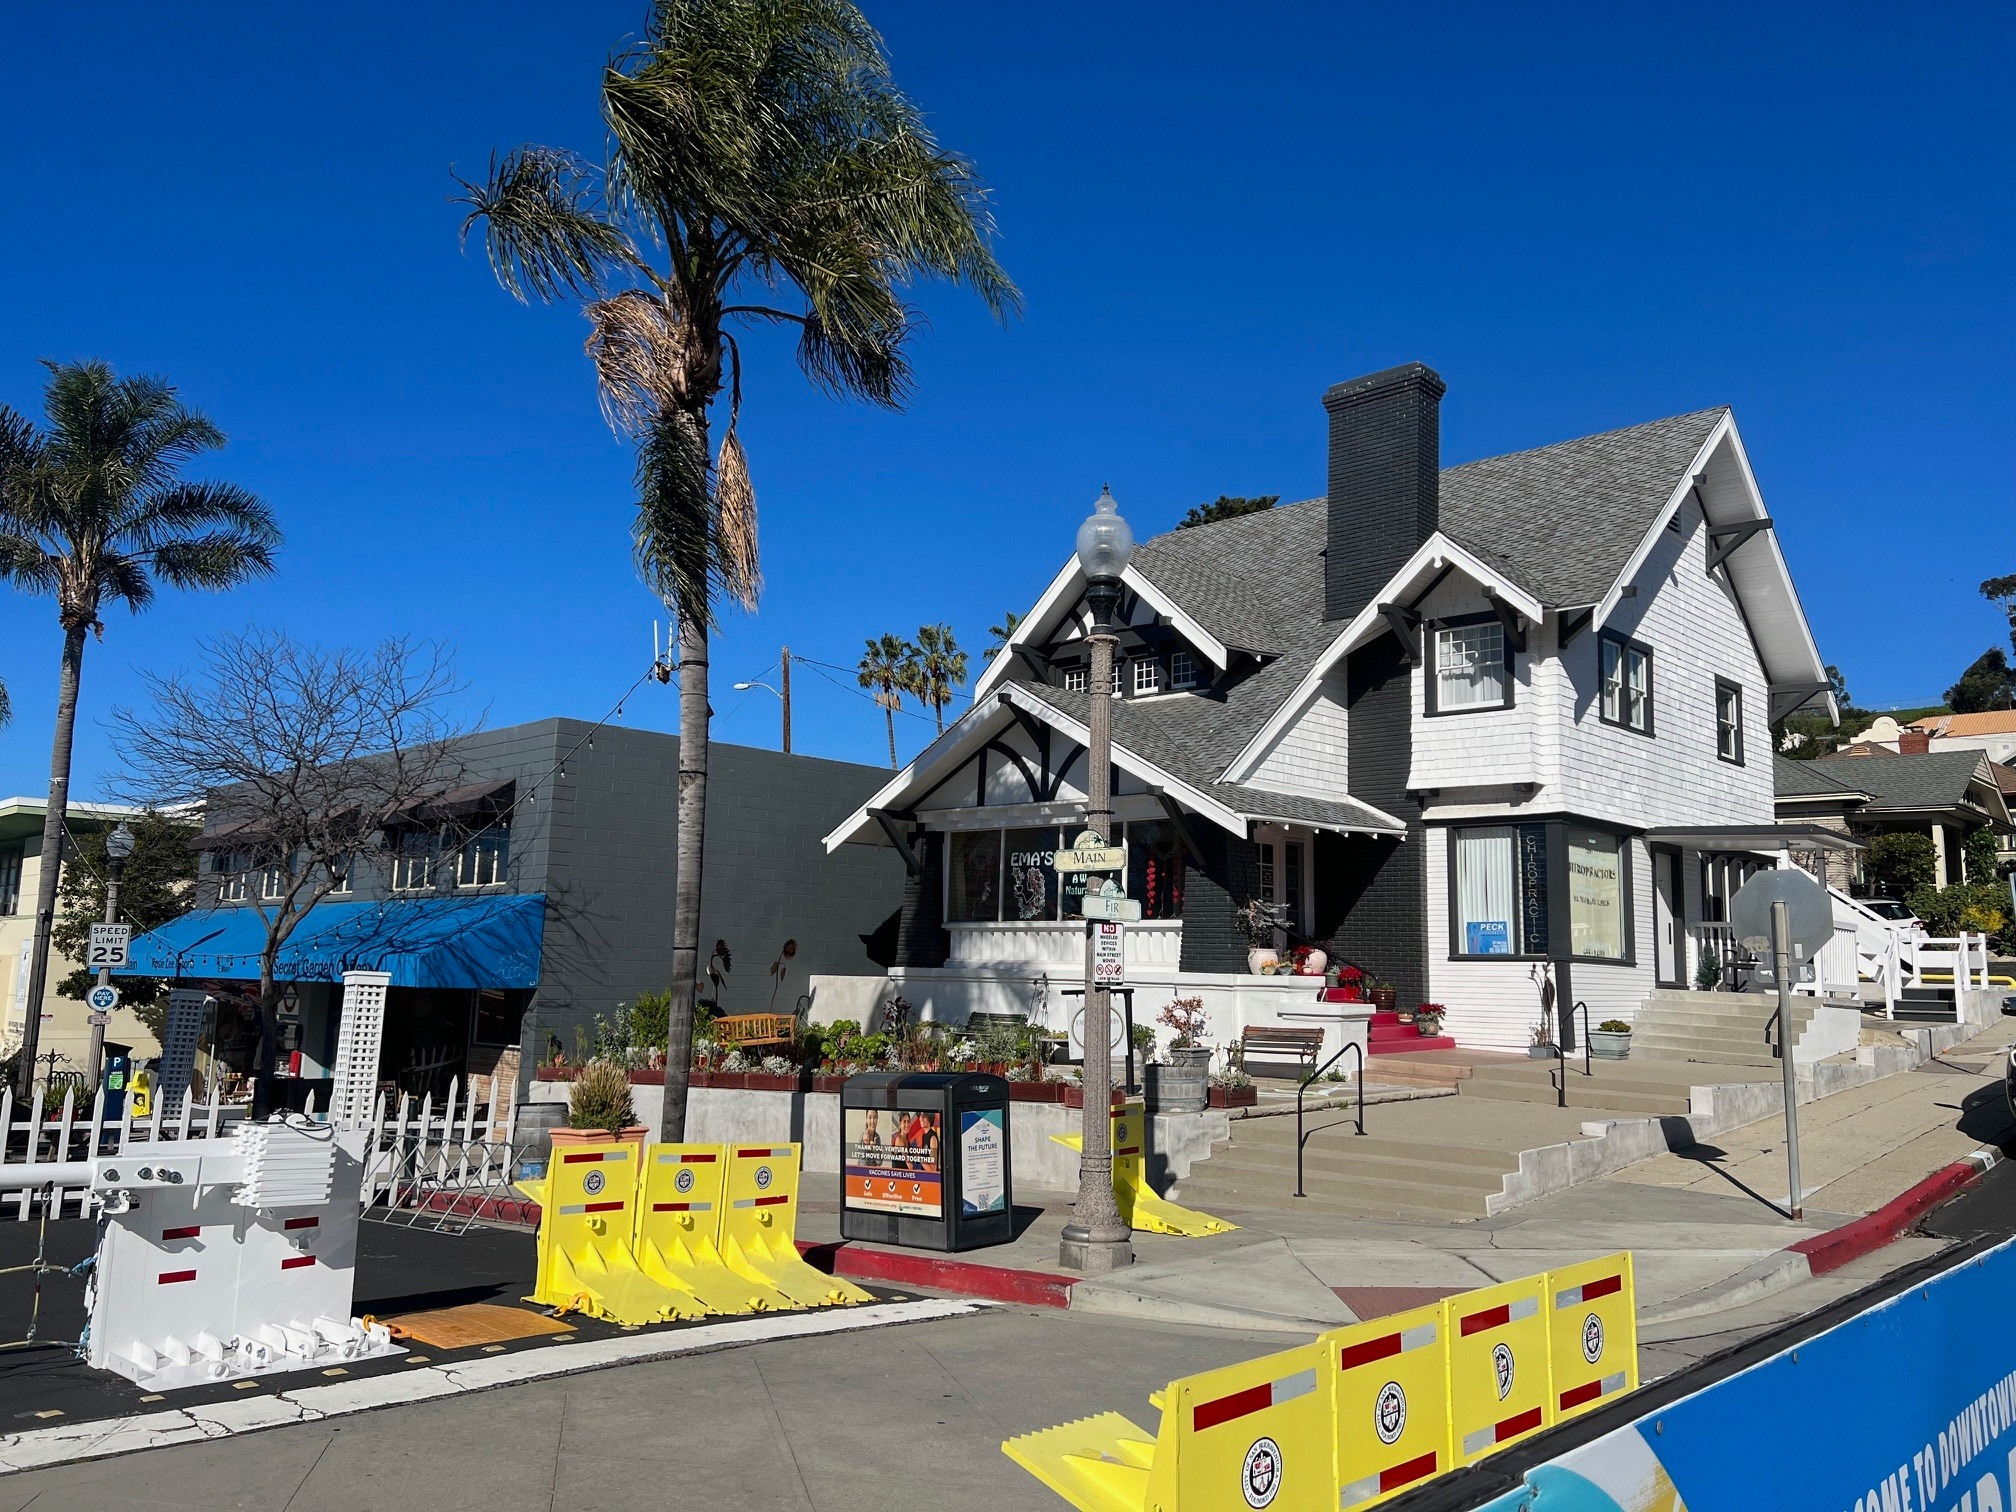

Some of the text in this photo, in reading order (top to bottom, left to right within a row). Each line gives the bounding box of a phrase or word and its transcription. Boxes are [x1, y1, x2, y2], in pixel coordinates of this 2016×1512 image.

[1010, 851, 1055, 867] EMA'S
[1073, 851, 1106, 864] MAIN
[1569, 861, 1617, 880] HIROPRACTORS
[1072, 873, 1079, 884] A
[1526, 835, 1540, 943] CHIROPRACTIC
[1105, 900, 1120, 913] FIR
[93, 927, 128, 935] SPEED
[1103, 924, 1115, 933] NO
[1480, 923, 1505, 931] PECK
[91, 947, 124, 963] 25
[273, 959, 300, 976] Secret
[302, 957, 335, 976] Garden
[113, 1056, 121, 1067] P
[974, 1135, 991, 1144] SHAPE
[884, 1145, 908, 1153] VENTURA
[908, 1147, 932, 1155] COUNTY
[967, 1143, 998, 1152] THE FUTURE
[880, 1153, 906, 1161] FORWARD
[906, 1155, 935, 1163] TOGETHER
[868, 1169, 916, 1179] VACCINES SAVE LIVES
[863, 1190, 873, 1198] Safe
[882, 1192, 902, 1200] Effective
[1913, 1443, 1937, 1512] TO
[1938, 1369, 2016, 1490] DOWNTOWN
